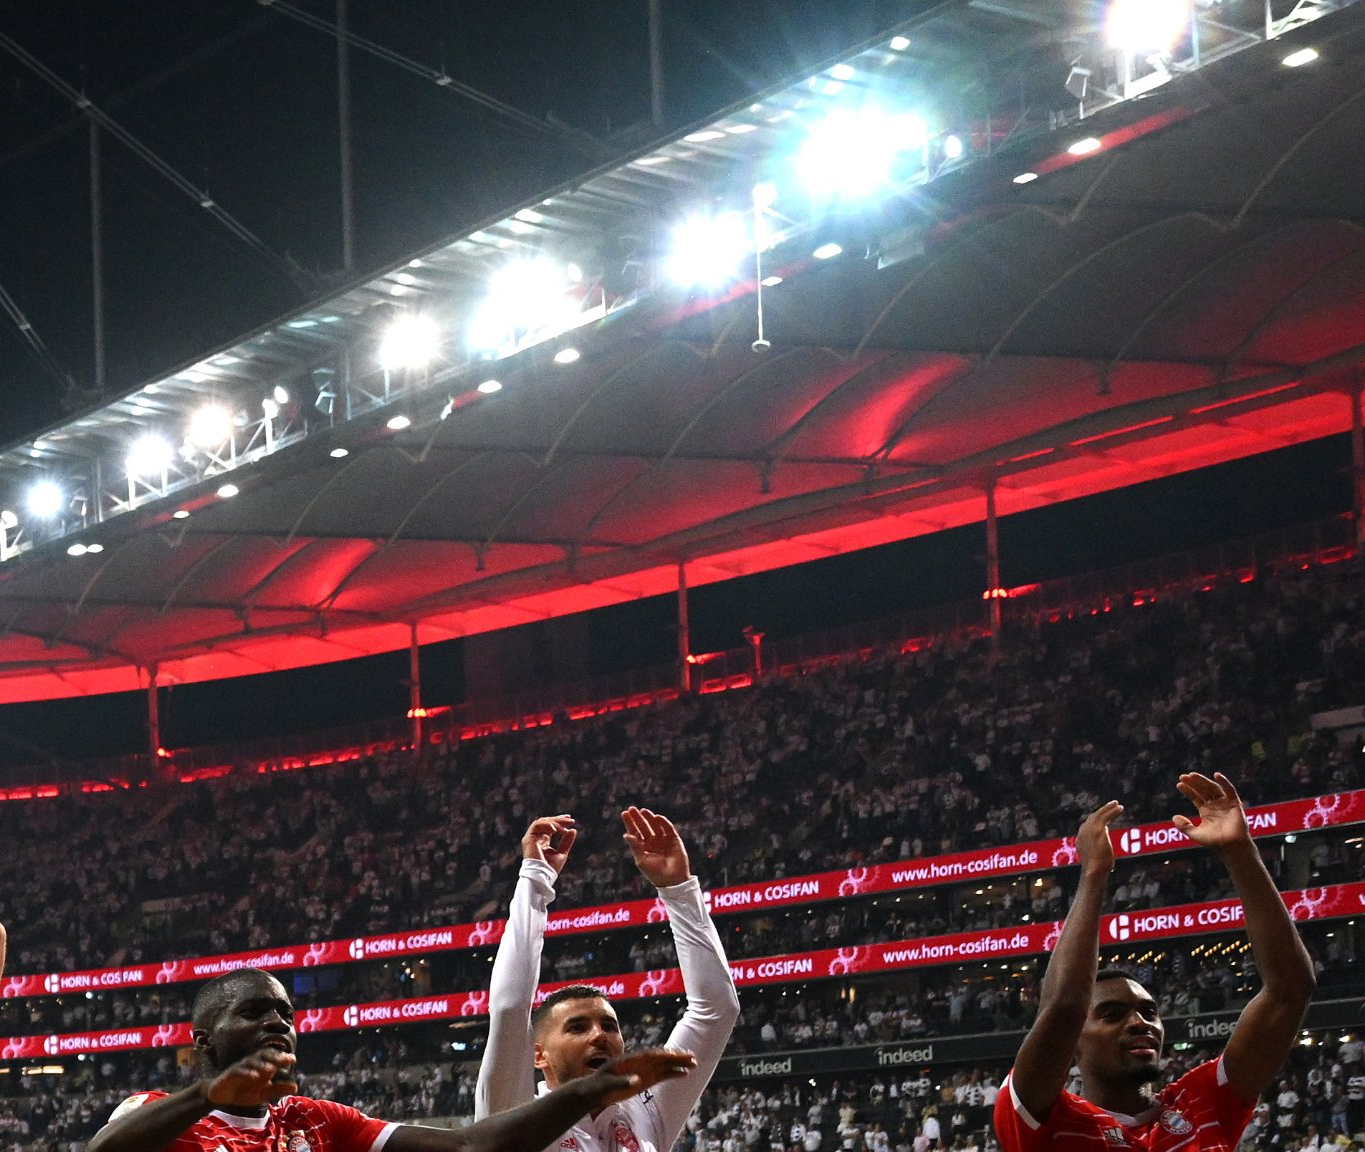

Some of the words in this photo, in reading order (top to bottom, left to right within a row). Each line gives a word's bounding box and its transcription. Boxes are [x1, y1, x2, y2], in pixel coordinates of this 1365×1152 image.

[892, 850, 1038, 884] www.horn-cosifan.de
[714, 891, 751, 908] HORN
[754, 891, 762, 903] &
[764, 880, 820, 901] COSIFAN
[1134, 910, 1180, 933] HORN
[1183, 914, 1194, 927] &
[1198, 905, 1245, 926] COSIF
[365, 940, 396, 954] HORN
[398, 939, 406, 950] &
[407, 932, 453, 949] COSIFAN
[883, 934, 1029, 964] www.horn-cosifan.de
[194, 952, 295, 975] www.horn-cosifan.de
[747, 967, 755, 979] &
[759, 958, 813, 978] COSIFAN
[60, 974, 90, 988] HORN
[92, 976, 100, 986] &
[100, 970, 143, 985] COSFAN
[360, 1007, 391, 1021] HORN
[393, 1007, 401, 1018] &
[402, 1000, 448, 1016] COSIFAN
[60, 1036, 89, 1049] HORN
[91, 1037, 98, 1047] &
[100, 1032, 142, 1047] COSIFAN
[874, 1046, 934, 1066] indeed
[739, 1057, 793, 1077] indeed
